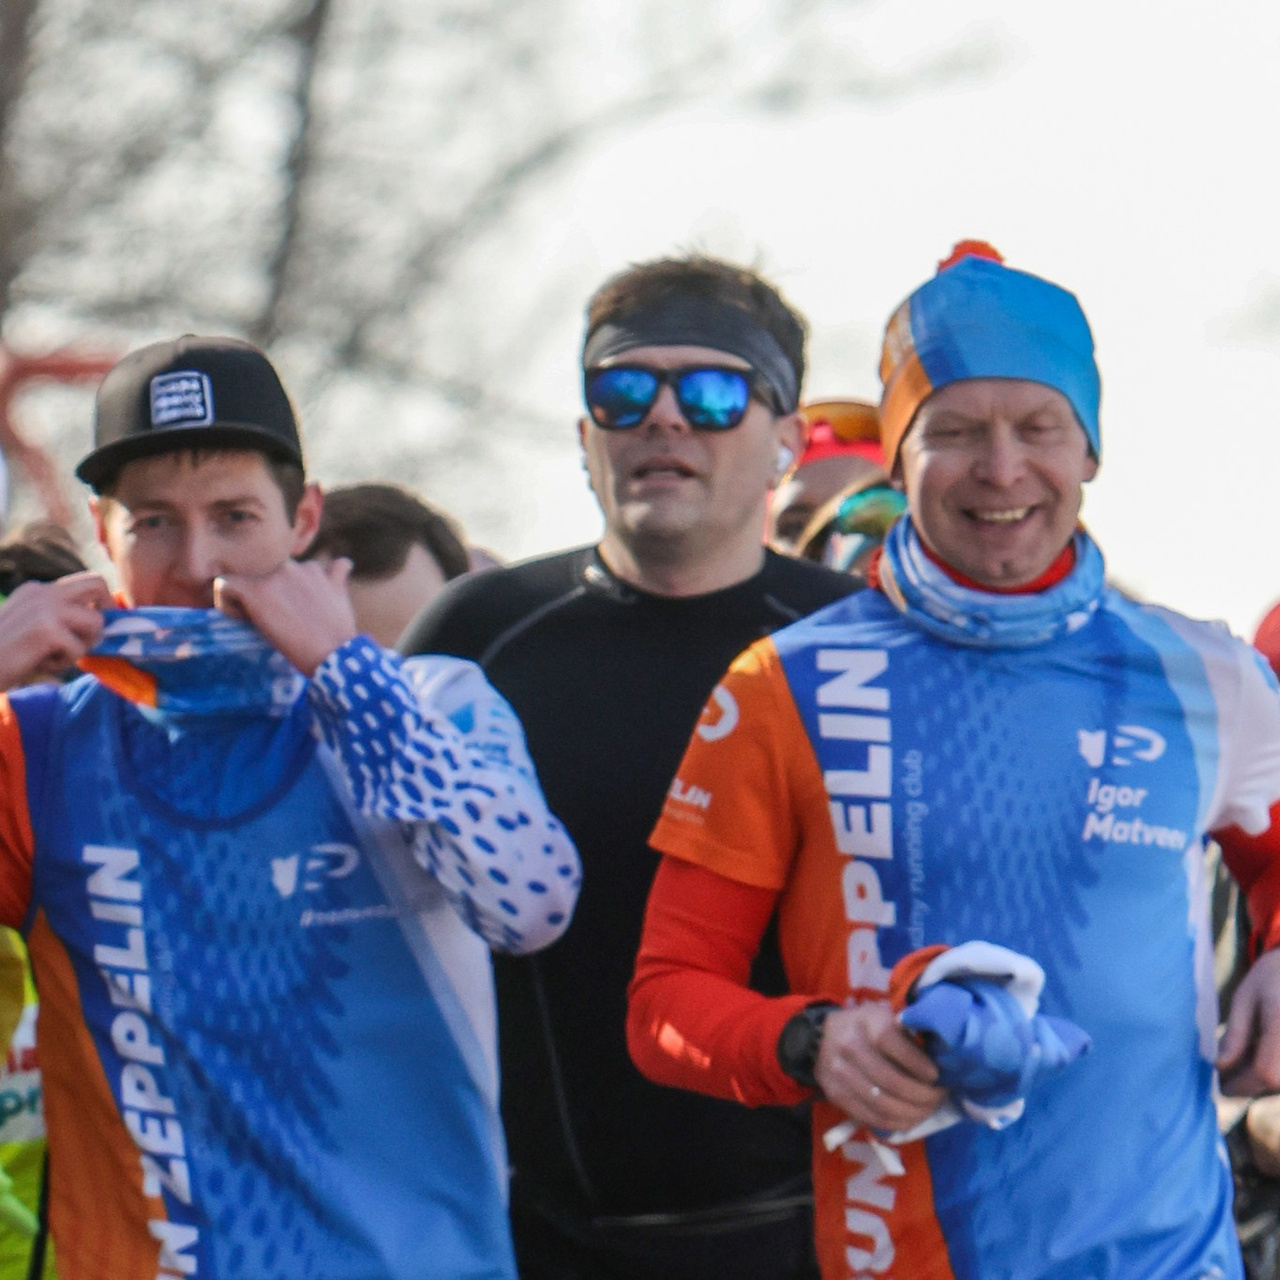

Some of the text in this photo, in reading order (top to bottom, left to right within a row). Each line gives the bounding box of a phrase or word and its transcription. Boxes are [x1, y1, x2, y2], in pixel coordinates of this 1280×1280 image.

[816, 649, 896, 1003] PPELIN
[901, 749, 924, 797] club
[1087, 777, 1148, 813] Igor
[82, 844, 192, 1204] ZEPPELIN
